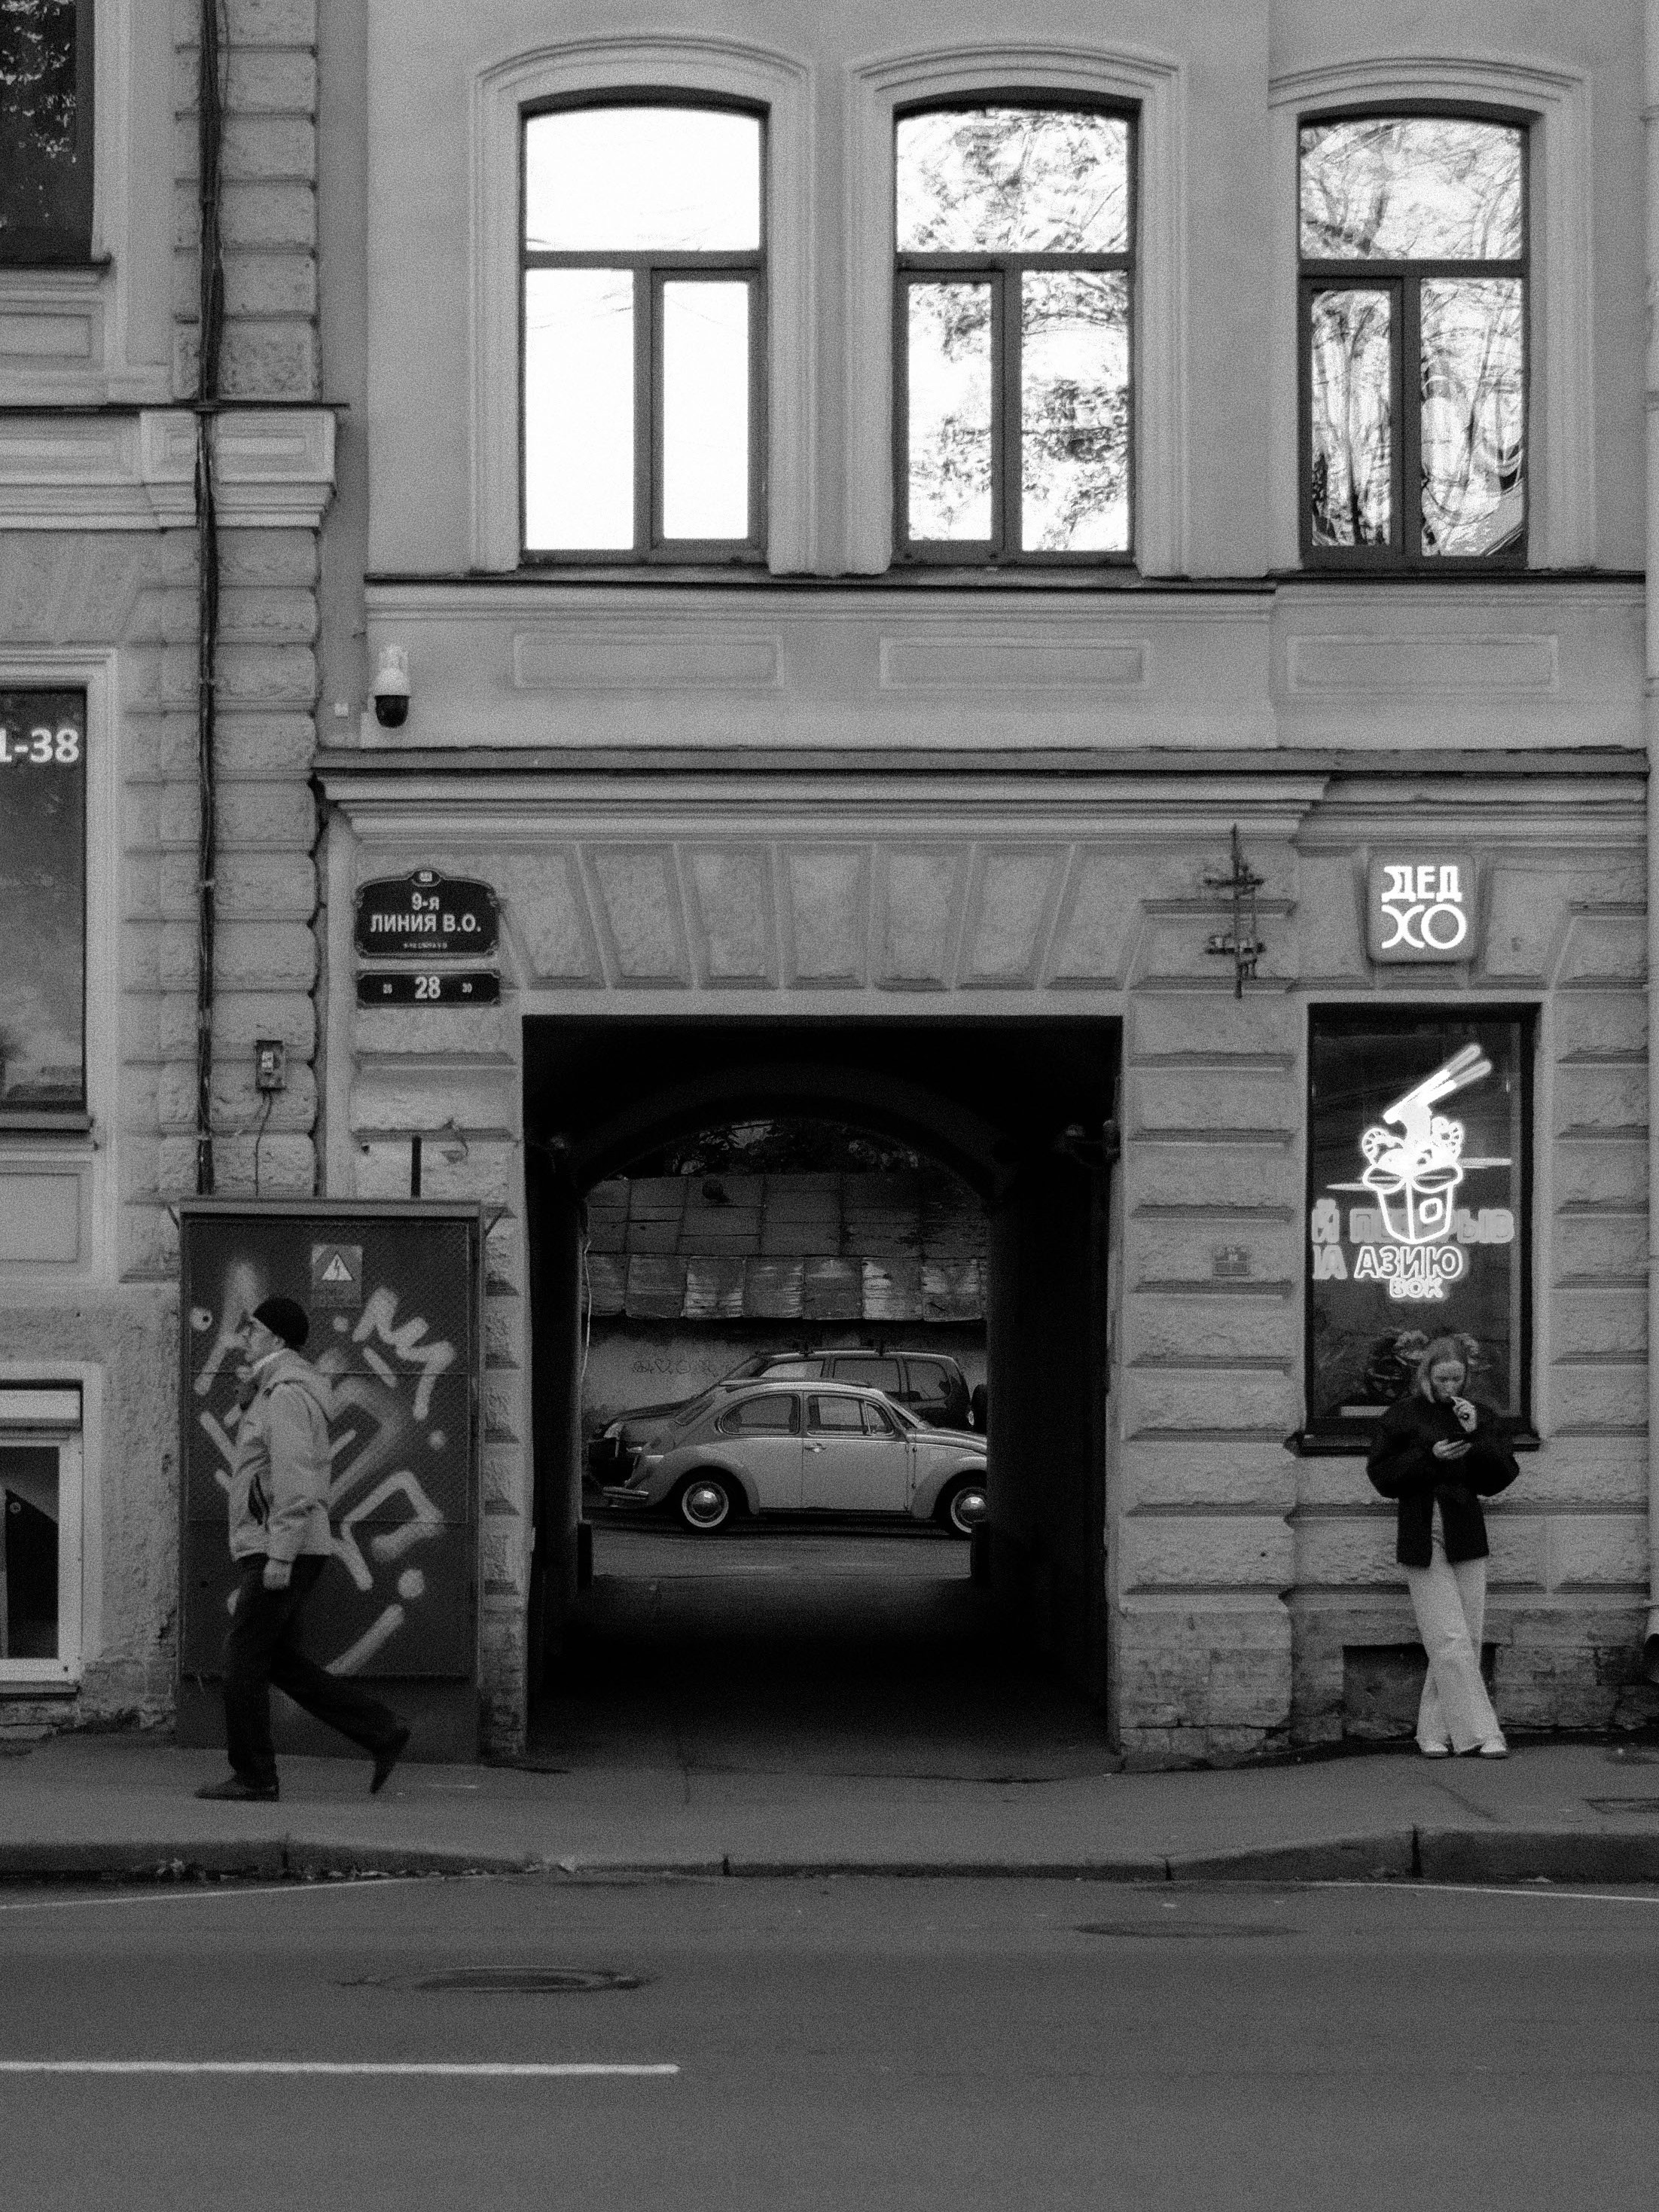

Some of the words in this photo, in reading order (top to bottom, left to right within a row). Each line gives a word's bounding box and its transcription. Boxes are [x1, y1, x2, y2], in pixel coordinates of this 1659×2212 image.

[1381, 865, 1462, 902] ДЕД
[411, 892, 440, 911] 9-я
[371, 914, 437, 932] ЛИНИЯ
[443, 914, 482, 932] В.О.
[1381, 903, 1467, 949] ХО
[414, 976, 441, 999] 28
[1349, 1208, 1515, 1243] ПЕРЫВ
[1354, 1246, 1463, 1279] АЗИЮ
[1389, 1277, 1444, 1298] ВОК
